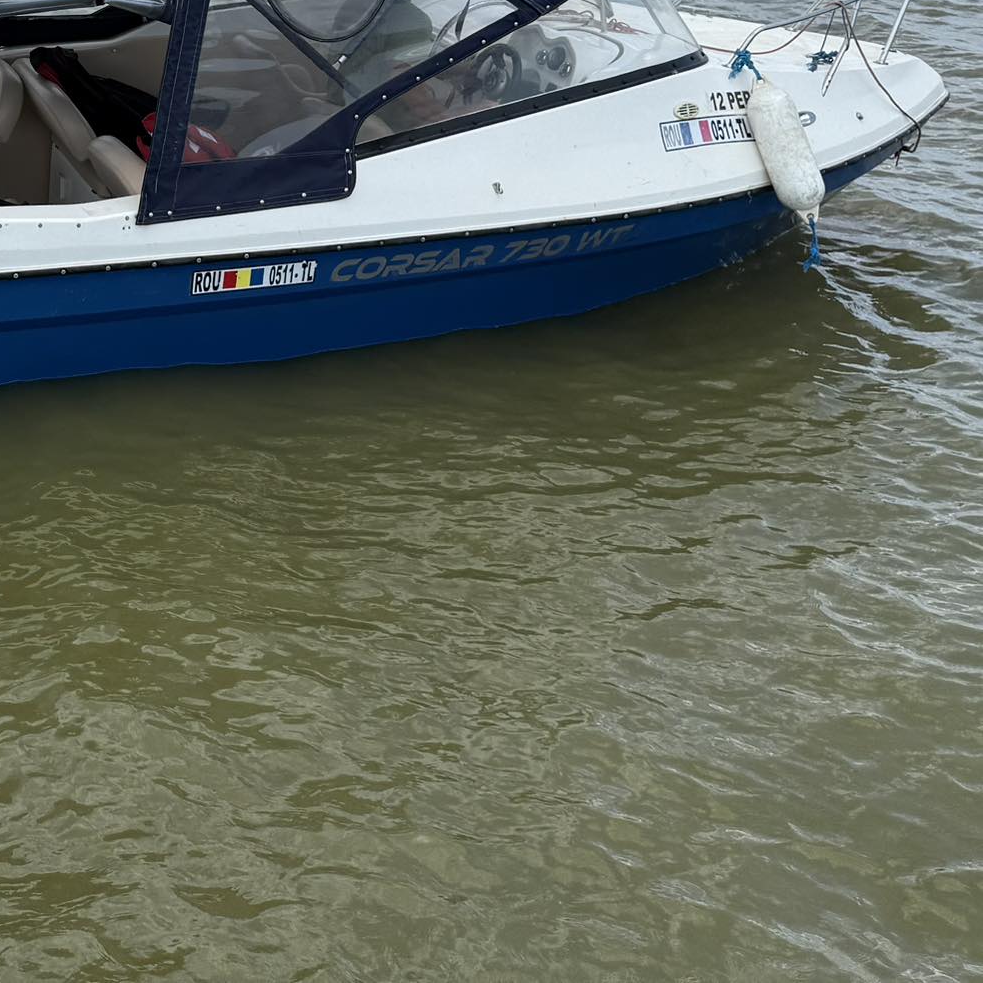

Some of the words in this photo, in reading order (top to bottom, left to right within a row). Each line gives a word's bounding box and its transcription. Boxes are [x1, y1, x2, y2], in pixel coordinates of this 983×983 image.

[710, 92, 726, 111] 12
[663, 123, 682, 148] ROU
[711, 118, 752, 140] 0511-TL
[329, 244, 495, 282] CORSAR
[499, 234, 570, 264] 730
[576, 224, 635, 252] WT
[194, 271, 221, 293] ROU
